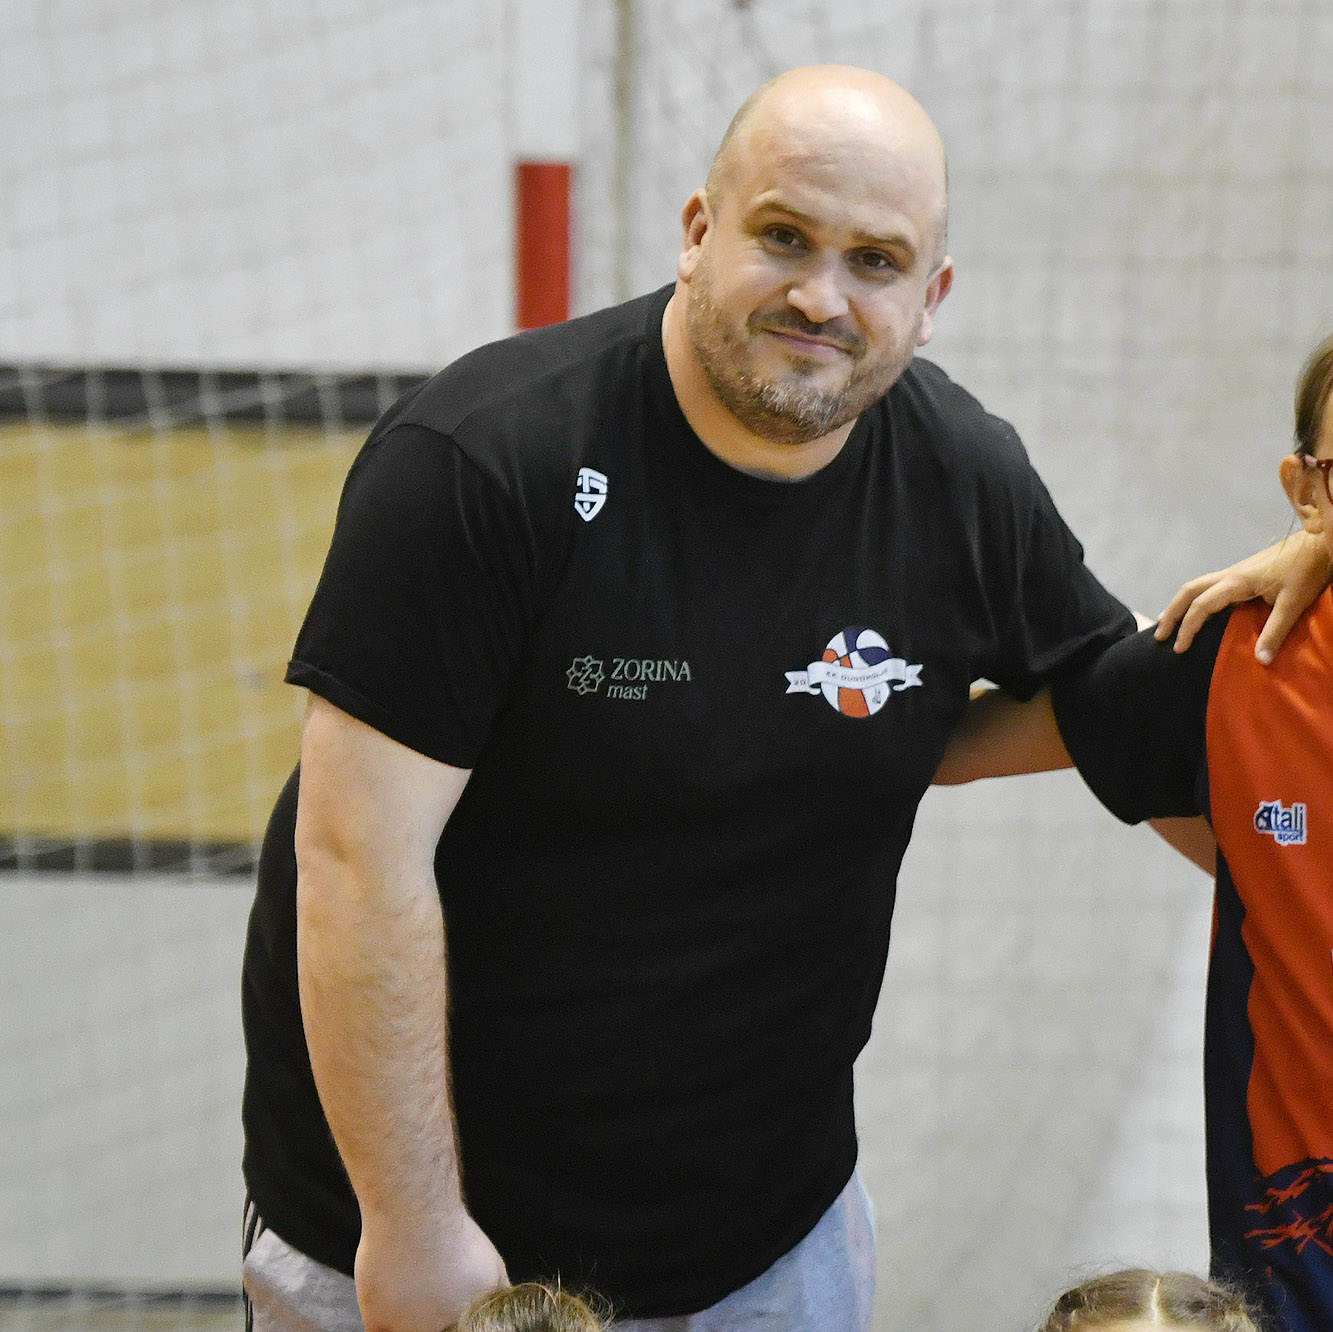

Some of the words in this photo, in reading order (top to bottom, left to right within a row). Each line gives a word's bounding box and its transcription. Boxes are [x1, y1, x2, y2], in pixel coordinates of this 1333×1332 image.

[611, 658, 692, 682] ZORINA
[606, 684, 648, 701] mast
[1256, 805, 1304, 831] Atali
[1277, 831, 1304, 842] sport
